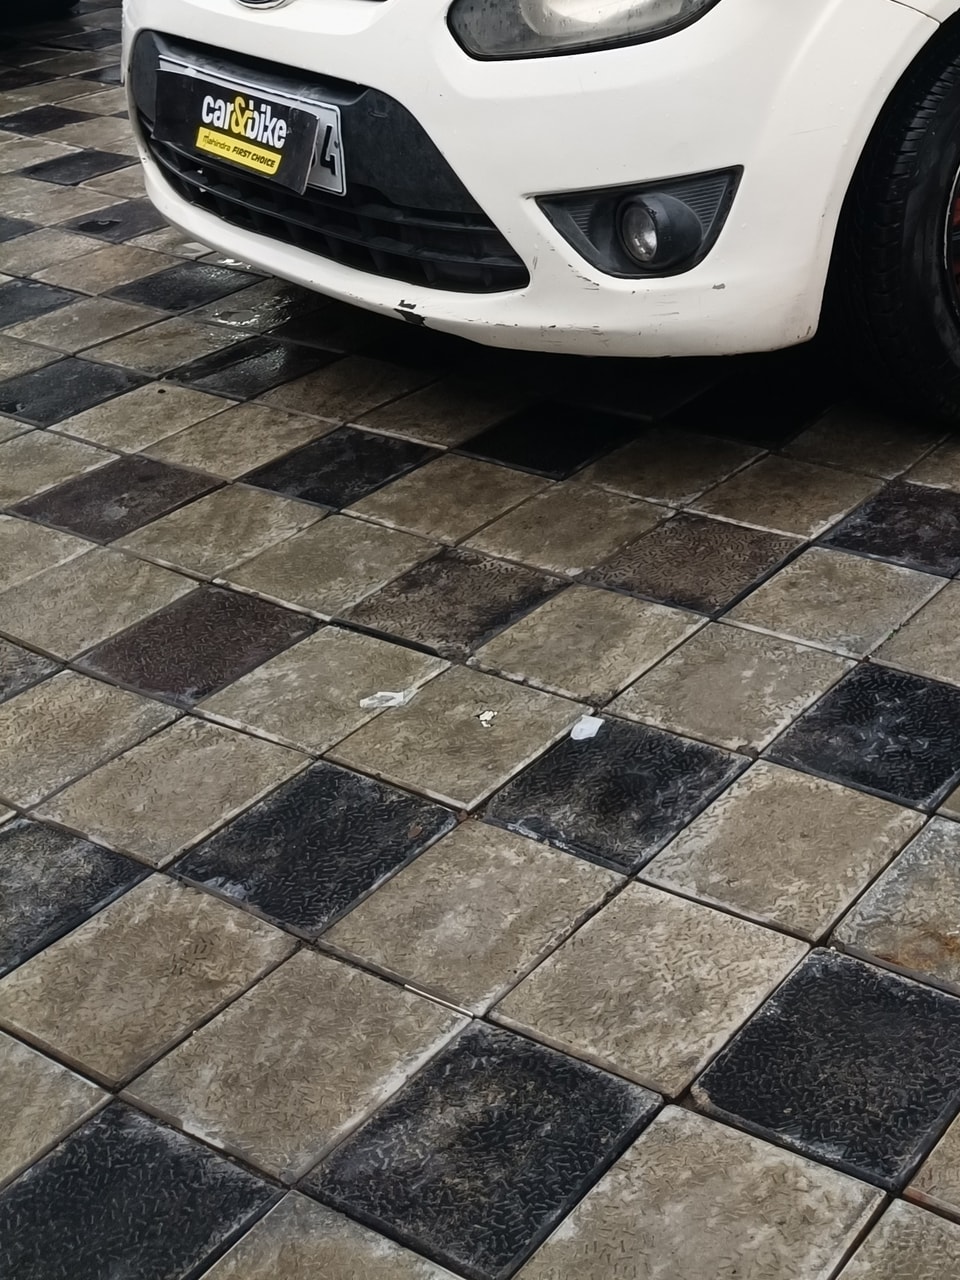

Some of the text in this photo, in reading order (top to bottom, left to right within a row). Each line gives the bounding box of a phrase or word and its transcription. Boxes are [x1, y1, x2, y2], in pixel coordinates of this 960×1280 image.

[202, 95, 287, 149] car&bike
[232, 146, 252, 159] FIRST
[251, 153, 276, 168] CHOICE
